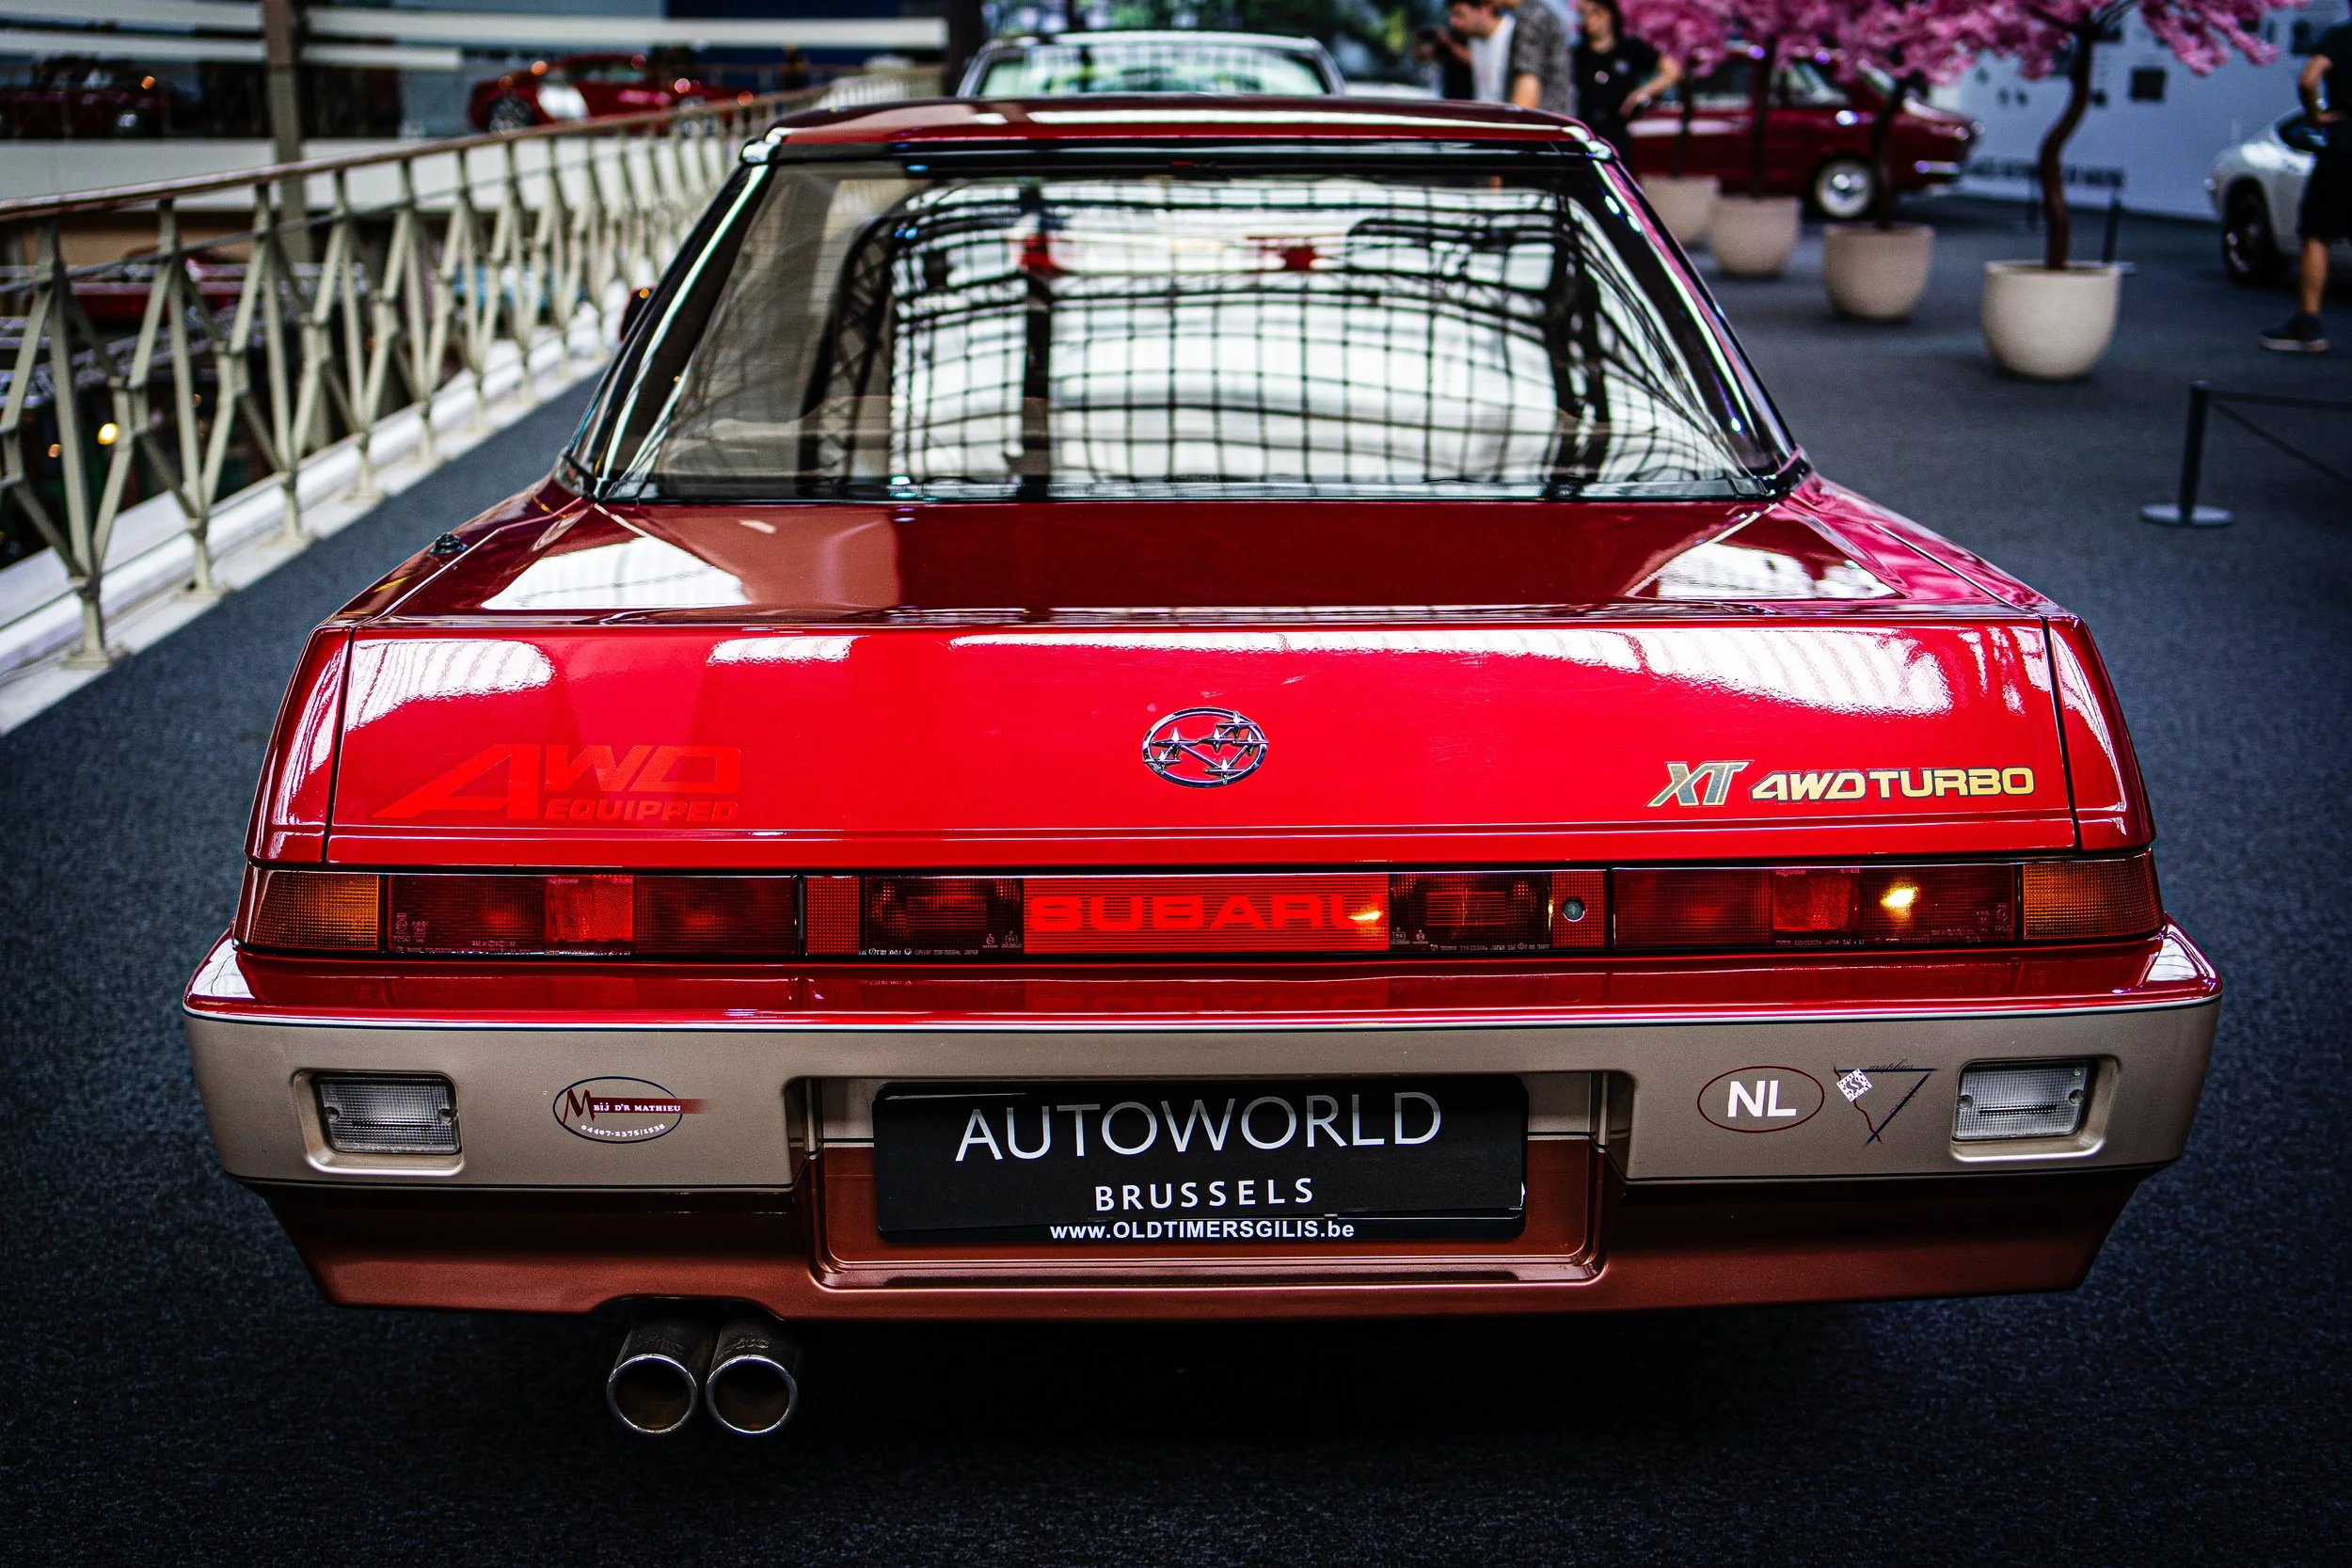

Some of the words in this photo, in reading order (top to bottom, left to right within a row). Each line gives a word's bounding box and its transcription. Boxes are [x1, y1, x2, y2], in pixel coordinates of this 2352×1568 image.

[373, 743, 741, 820] AWD
[1646, 759, 1752, 809] XT
[1867, 766, 2035, 799] TURBO
[545, 800, 739, 820] EQUIPPED
[1029, 894, 1384, 931] SUBARU
[1727, 1080, 1798, 1117] NL
[955, 1091, 1442, 1163] AUTOWORLD
[1094, 1178, 1314, 1212] BRUSSELS
[1049, 1219, 1356, 1240] www.OLDTIMERSGILIS.be
